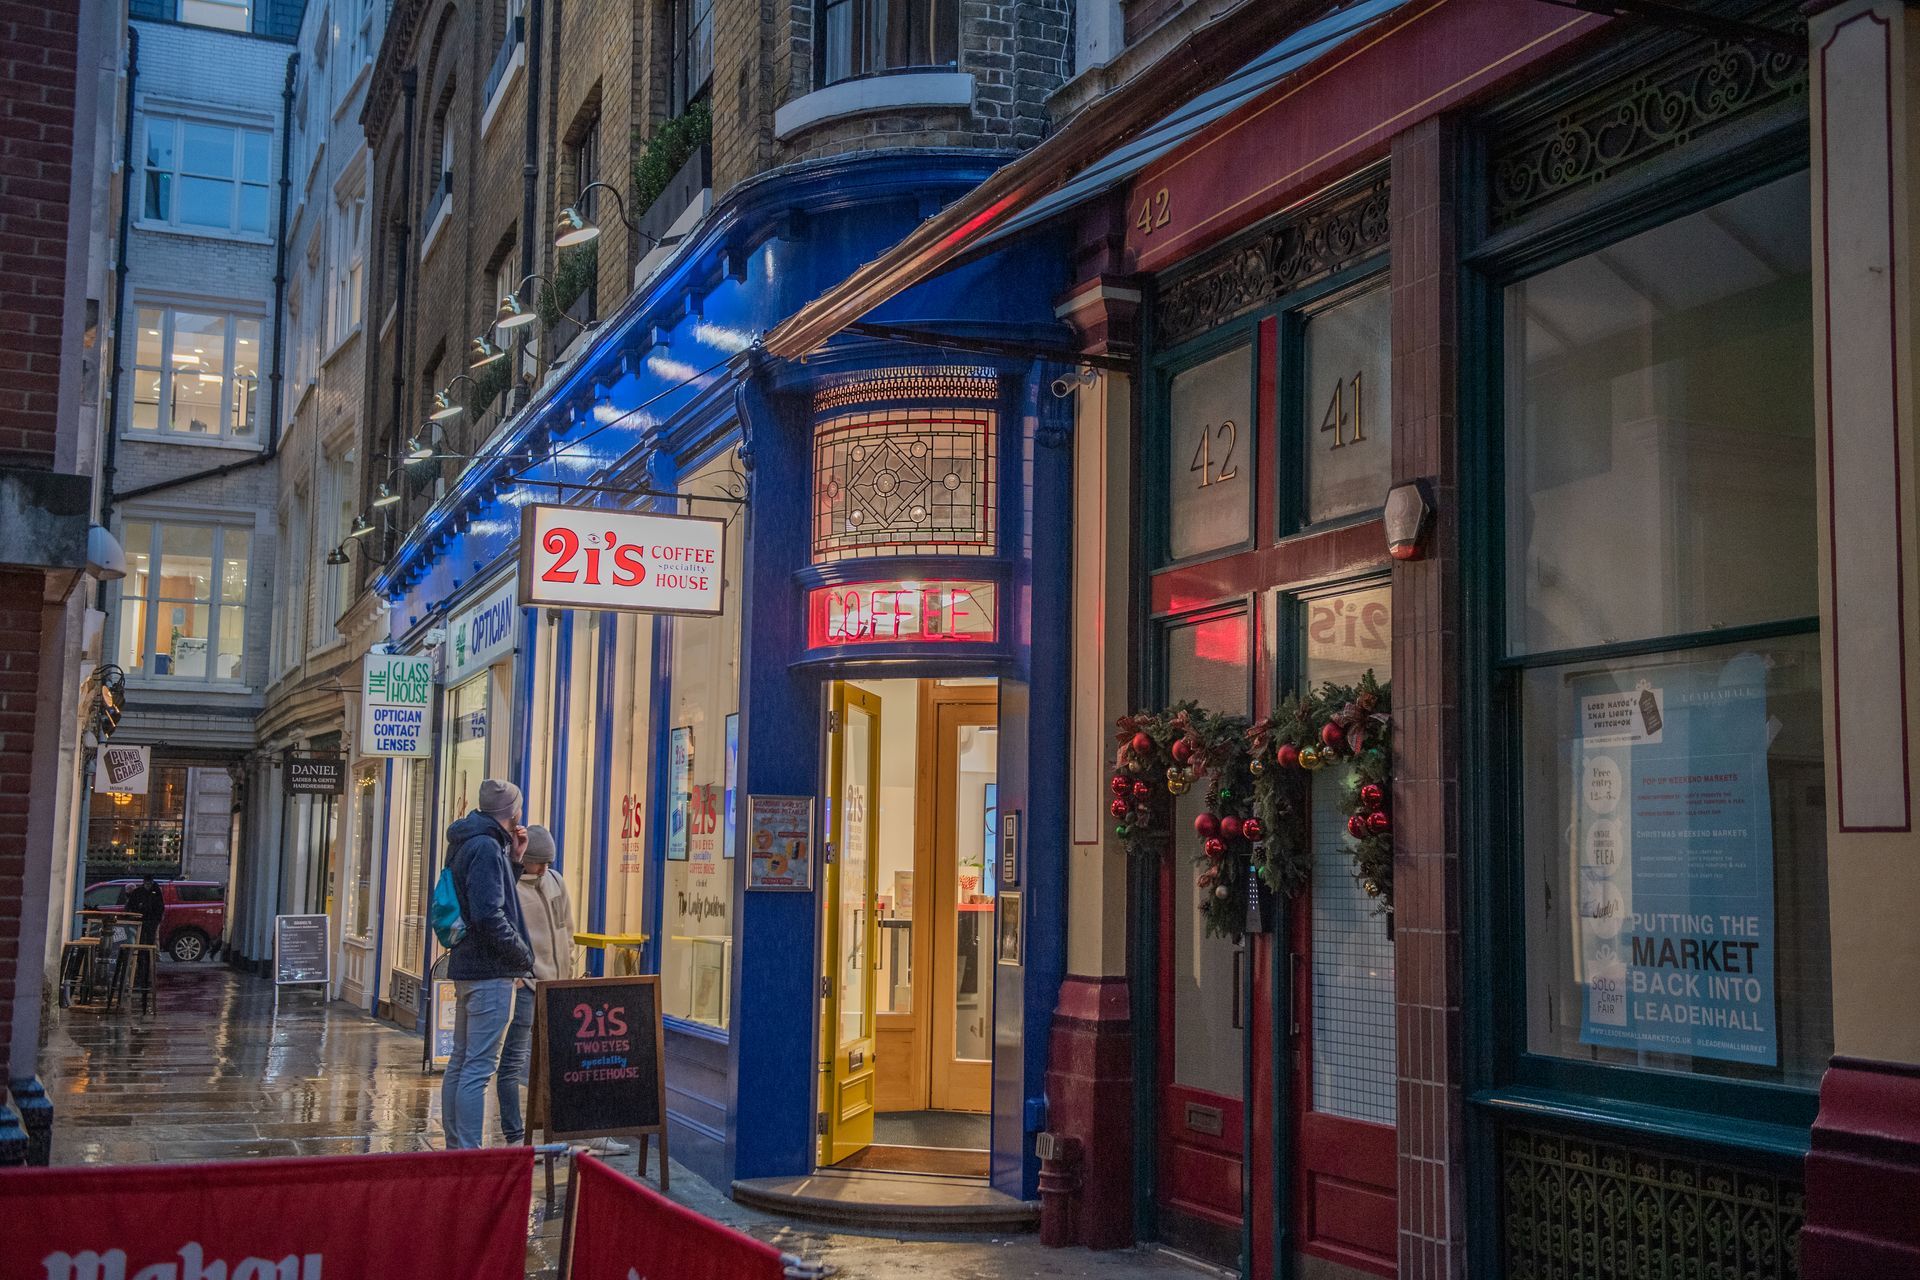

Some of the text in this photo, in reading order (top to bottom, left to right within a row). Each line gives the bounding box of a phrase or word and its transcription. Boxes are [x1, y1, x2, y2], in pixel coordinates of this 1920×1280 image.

[1137, 187, 1171, 236] 42
[1320, 370, 1367, 451] 41
[1190, 419, 1238, 490] 42
[651, 545, 715, 564] COFFEE
[658, 563, 707, 575] speciality
[656, 573, 709, 591] HOUSE
[471, 594, 513, 656] OPTICIAN
[824, 588, 972, 644] COFFEE
[392, 661, 430, 683] GLASS
[368, 670, 387, 696] THE
[391, 682, 429, 704] HOUSE
[374, 709, 423, 722] OPTICIAN
[374, 723, 421, 738] CONTACT
[377, 738, 417, 751] LENSES
[110, 750, 140, 765] PLANET
[114, 762, 144, 781] GRAPES
[292, 764, 338, 776] DANIEL
[1592, 768, 1612, 778] Free
[1591, 779, 1613, 790] entry
[1636, 829, 1676, 838] CHRISTMAS
[1712, 828, 1747, 838] MARKETS
[1632, 913, 1760, 937] PUTTING THE
[1632, 936, 1760, 975] MARKET
[1633, 970, 1761, 1004] BACK INTO
[1634, 1002, 1765, 1033] LEADENHALL
[1589, 1027, 1692, 1045] WWW.LEADENHALLMARKET.CO.UK
[574, 1039, 631, 1054] TWO EYES
[581, 1055, 627, 1070] speciality
